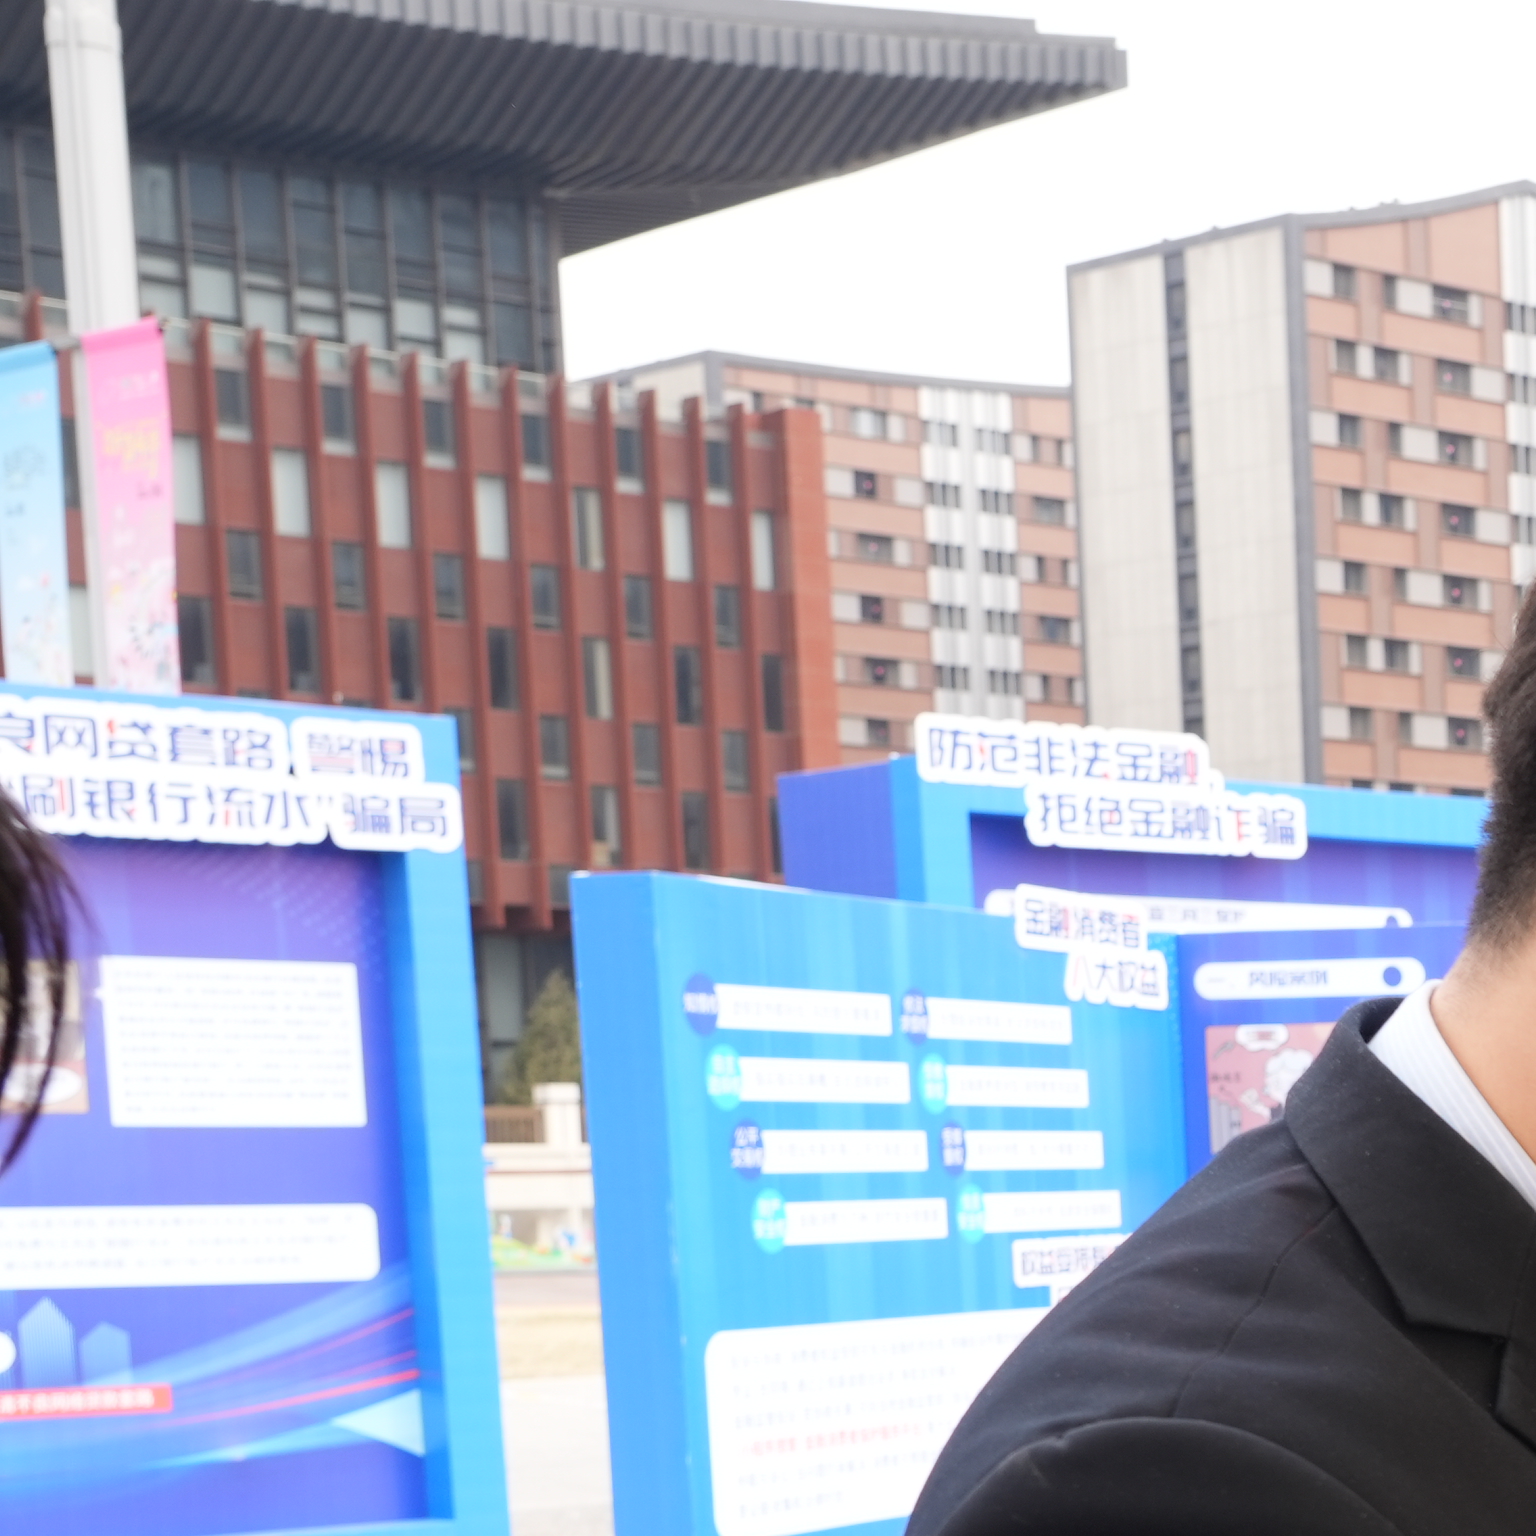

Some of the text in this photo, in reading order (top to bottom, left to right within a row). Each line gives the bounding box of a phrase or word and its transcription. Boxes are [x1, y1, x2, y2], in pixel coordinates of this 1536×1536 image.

[1038, 794, 1296, 845] 拒绝金融诈骗
[1024, 898, 1140, 948] 金融消费者
